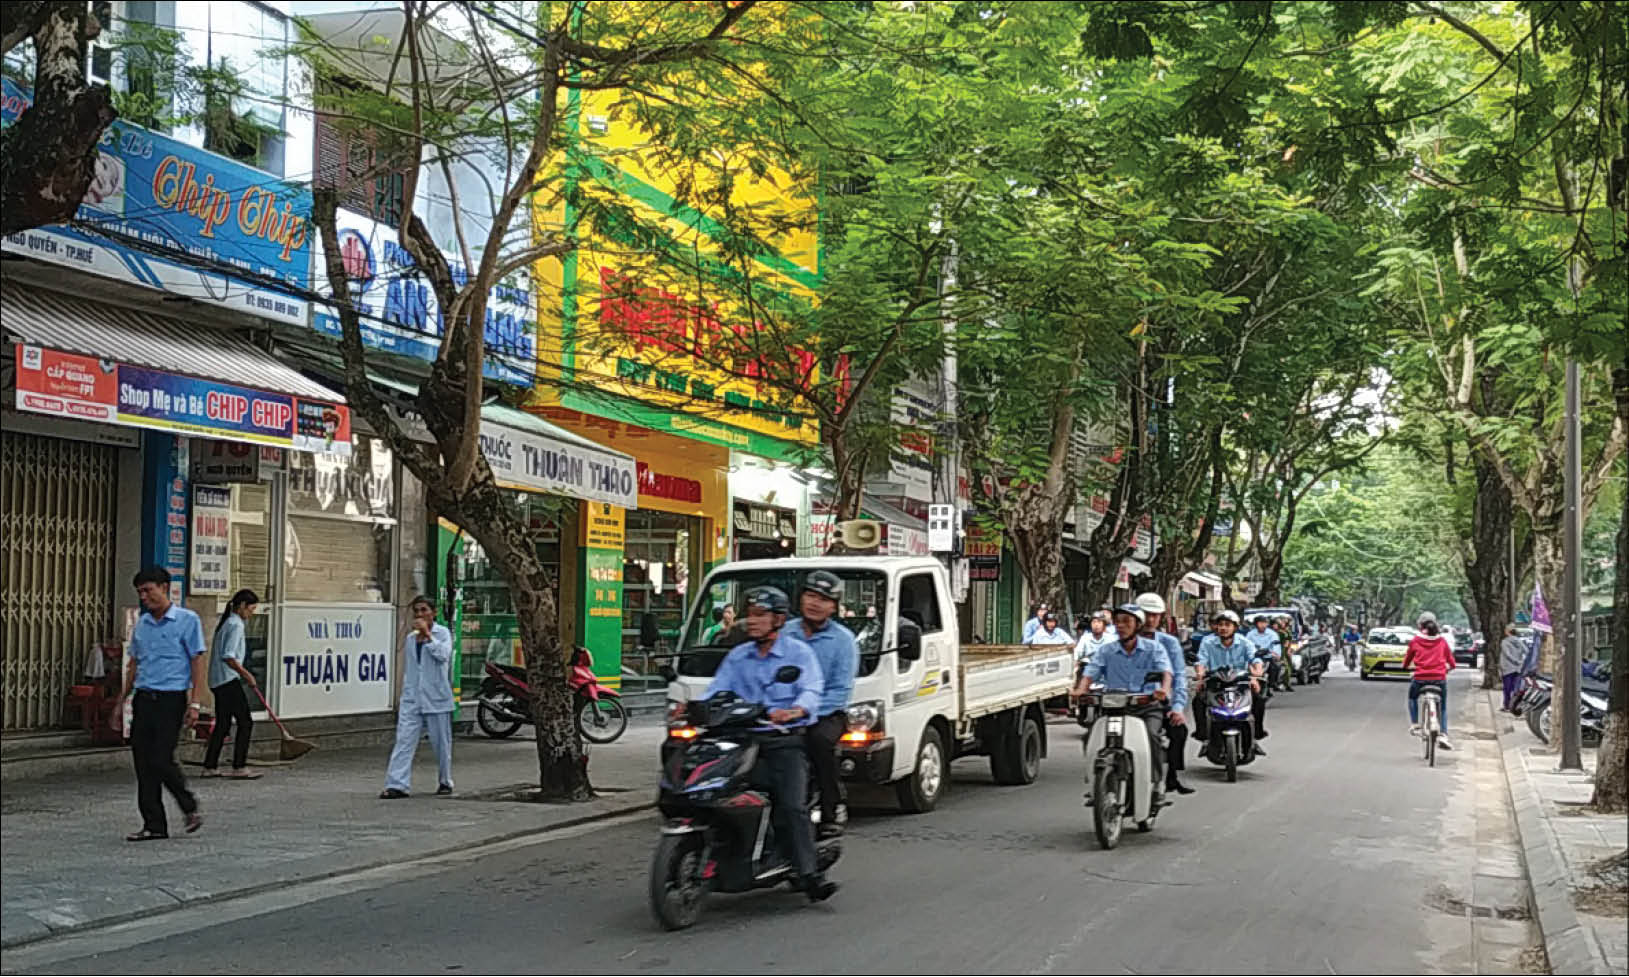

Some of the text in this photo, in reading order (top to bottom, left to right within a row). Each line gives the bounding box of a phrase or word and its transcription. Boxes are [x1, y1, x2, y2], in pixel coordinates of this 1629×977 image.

[152, 155, 307, 262] Chip Chip
[381, 276, 427, 330] AN
[120, 383, 150, 409] Shop
[153, 388, 170, 415] Mẹ
[173, 392, 187, 414] và
[188, 395, 204, 416] Bé
[207, 391, 249, 424] CHIP
[252, 398, 292, 430] CHIP
[480, 433, 512, 460] THUỐC
[589, 458, 633, 497] THẢO
[308, 618, 329, 639] NHÀ
[283, 648, 387, 692] THUẬN GIA
